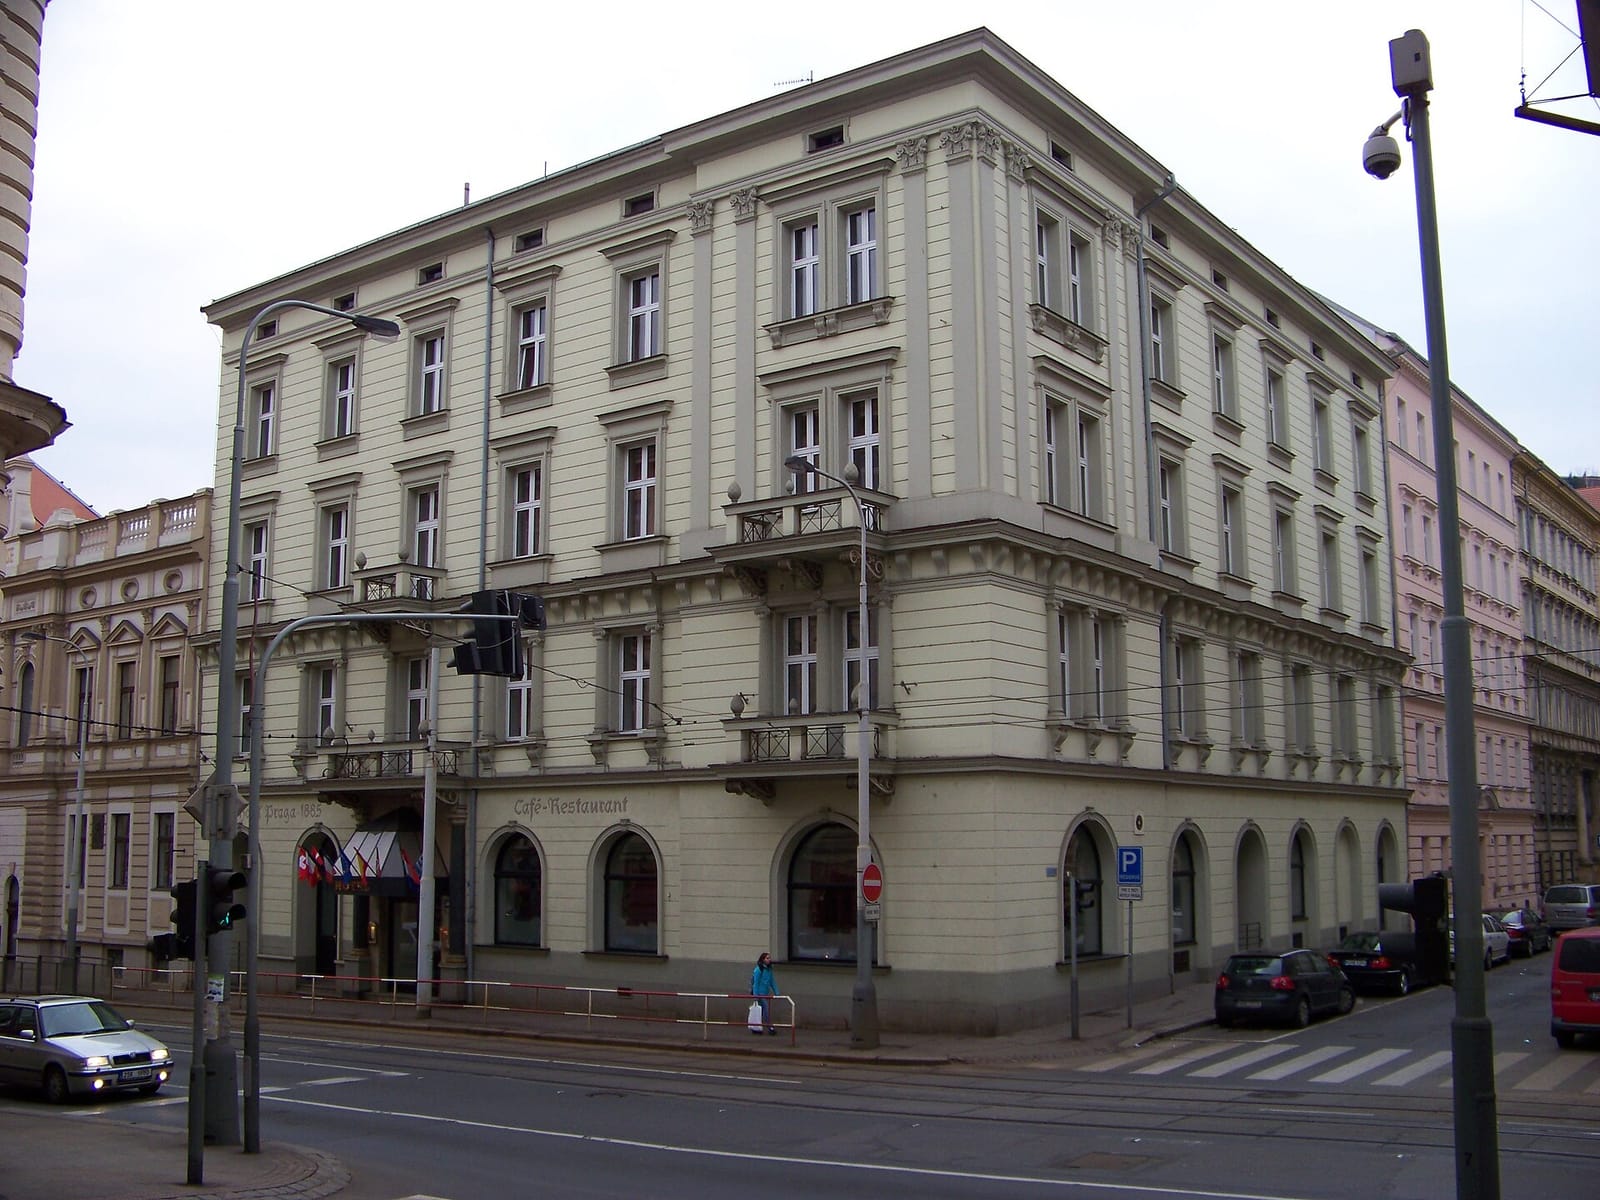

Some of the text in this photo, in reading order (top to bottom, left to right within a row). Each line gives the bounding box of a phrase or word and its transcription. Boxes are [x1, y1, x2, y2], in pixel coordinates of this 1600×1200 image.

[265, 804, 296, 824] Praga
[514, 796, 628, 821] Café-Restaurant
[1122, 851, 1137, 873] P
